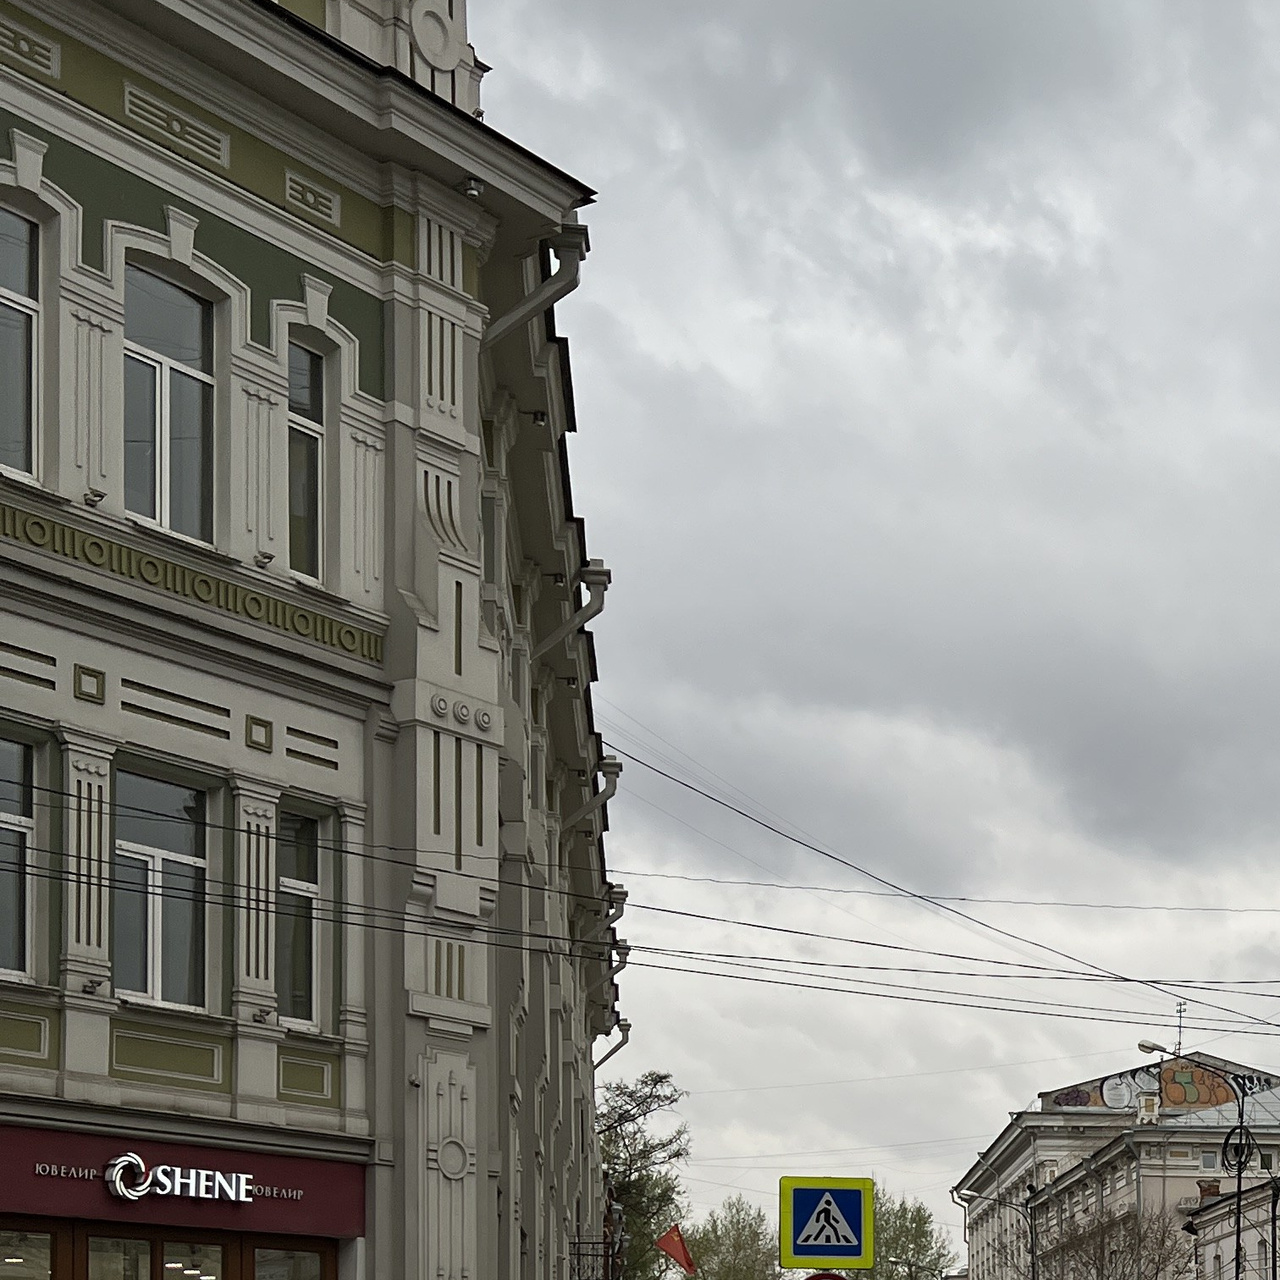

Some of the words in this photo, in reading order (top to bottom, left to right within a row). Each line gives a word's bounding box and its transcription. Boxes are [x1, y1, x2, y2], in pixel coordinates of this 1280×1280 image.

[35, 1163, 97, 1180] ЮВЕЛИР
[154, 1165, 253, 1203] SHENE
[252, 1184, 304, 1201] ЮВЕЛИР
